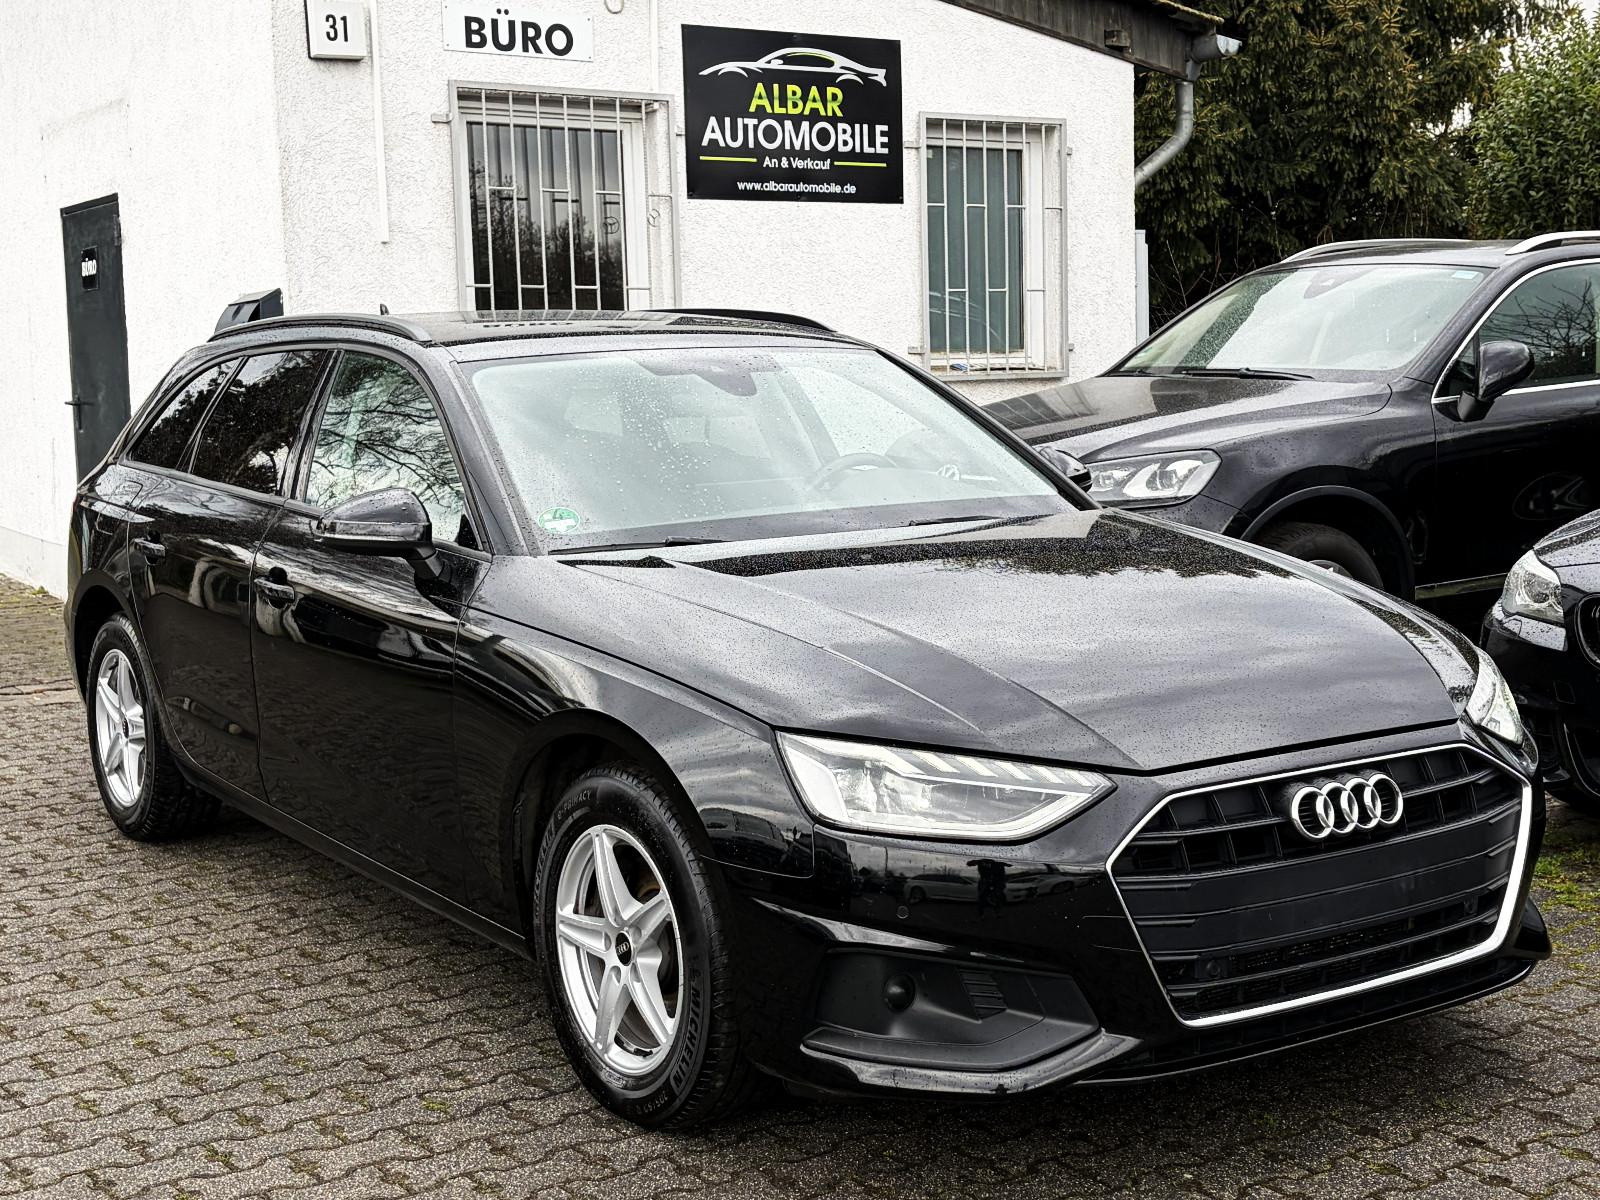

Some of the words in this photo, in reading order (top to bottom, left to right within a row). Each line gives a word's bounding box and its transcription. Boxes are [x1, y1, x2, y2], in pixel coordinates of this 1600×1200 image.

[324, 14, 349, 43] 31
[464, 8, 574, 57] BÜRO
[749, 82, 844, 117] ALBAR
[701, 116, 889, 154] AUTOMOBILE
[763, 155, 779, 168] An
[781, 157, 789, 168] &
[791, 157, 831, 170] Verkauf
[737, 180, 857, 194] www.albarautomobile.de
[673, 985, 701, 1089] MICHELIN
